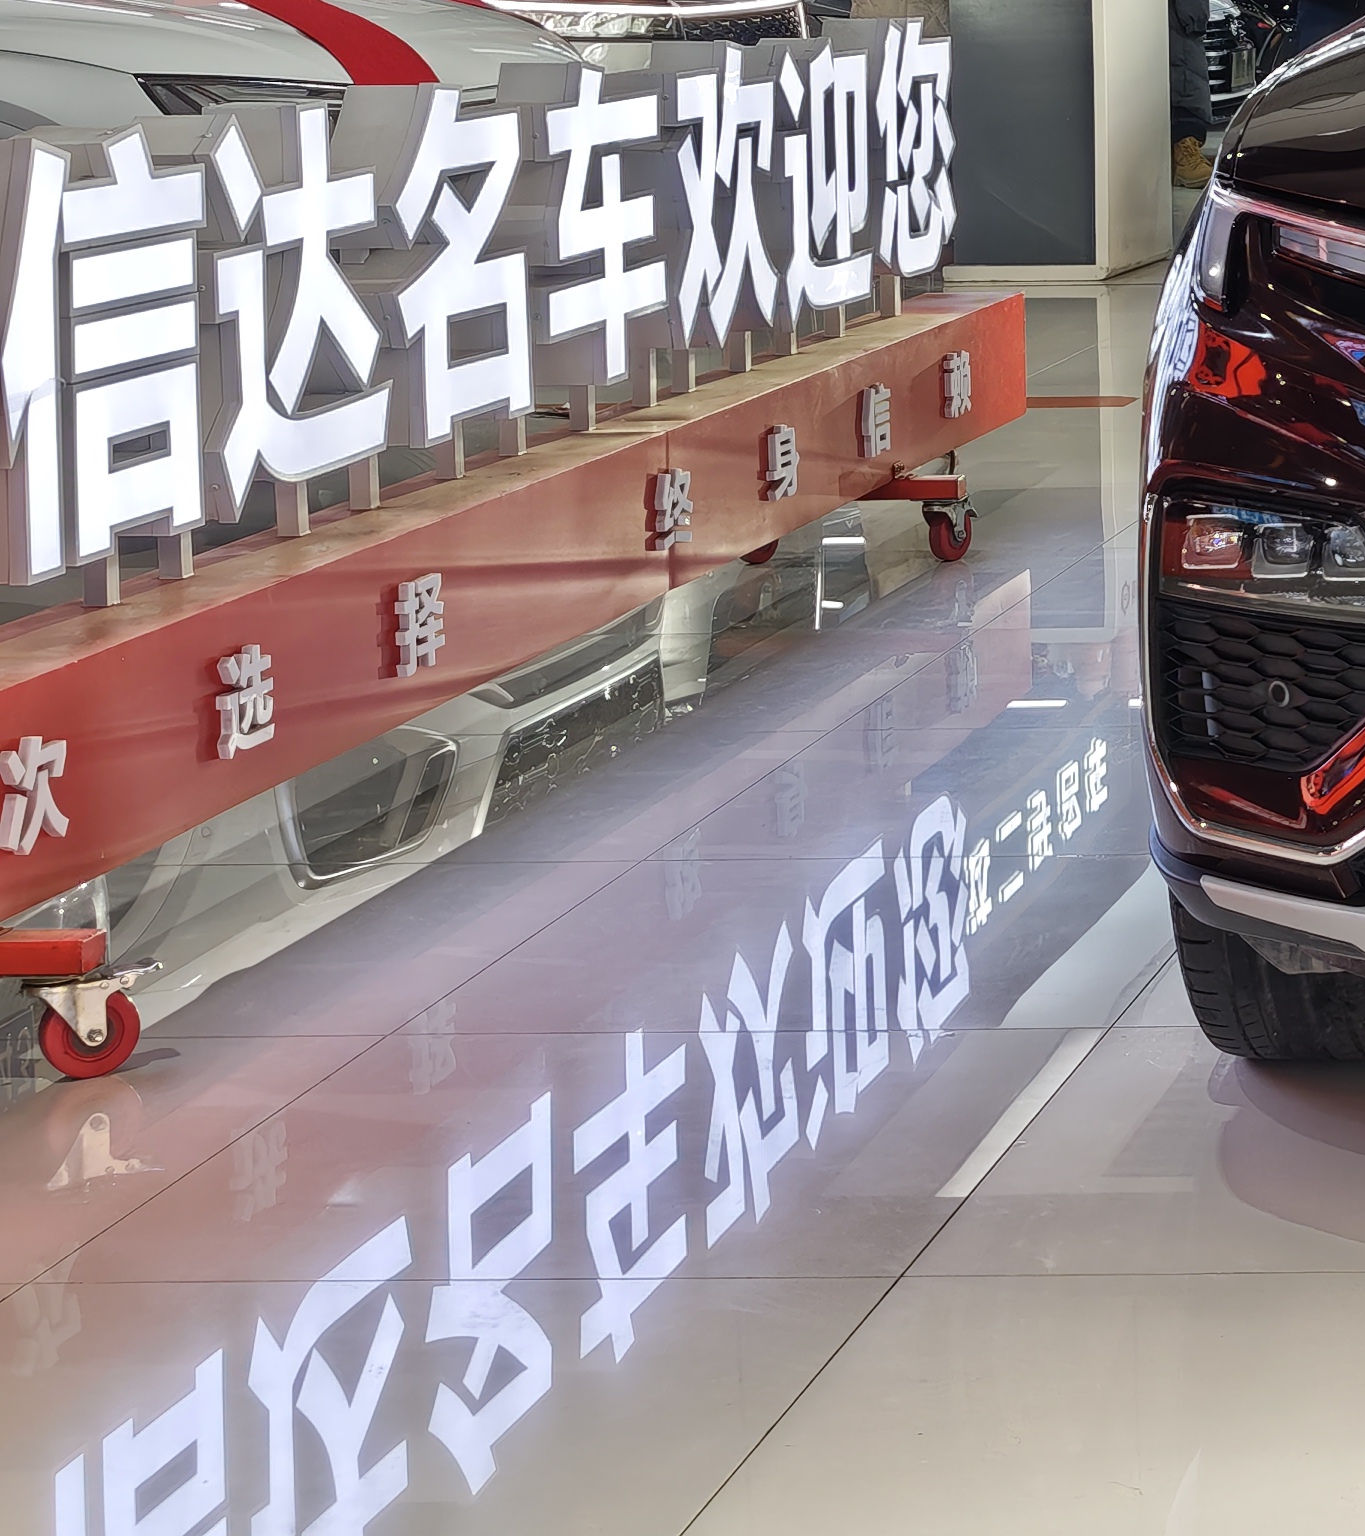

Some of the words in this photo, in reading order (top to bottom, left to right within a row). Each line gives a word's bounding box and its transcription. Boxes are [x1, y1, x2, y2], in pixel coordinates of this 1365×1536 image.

[0, 17, 957, 585] 信达名车欢迎您
[648, 348, 972, 556] 终身信赖
